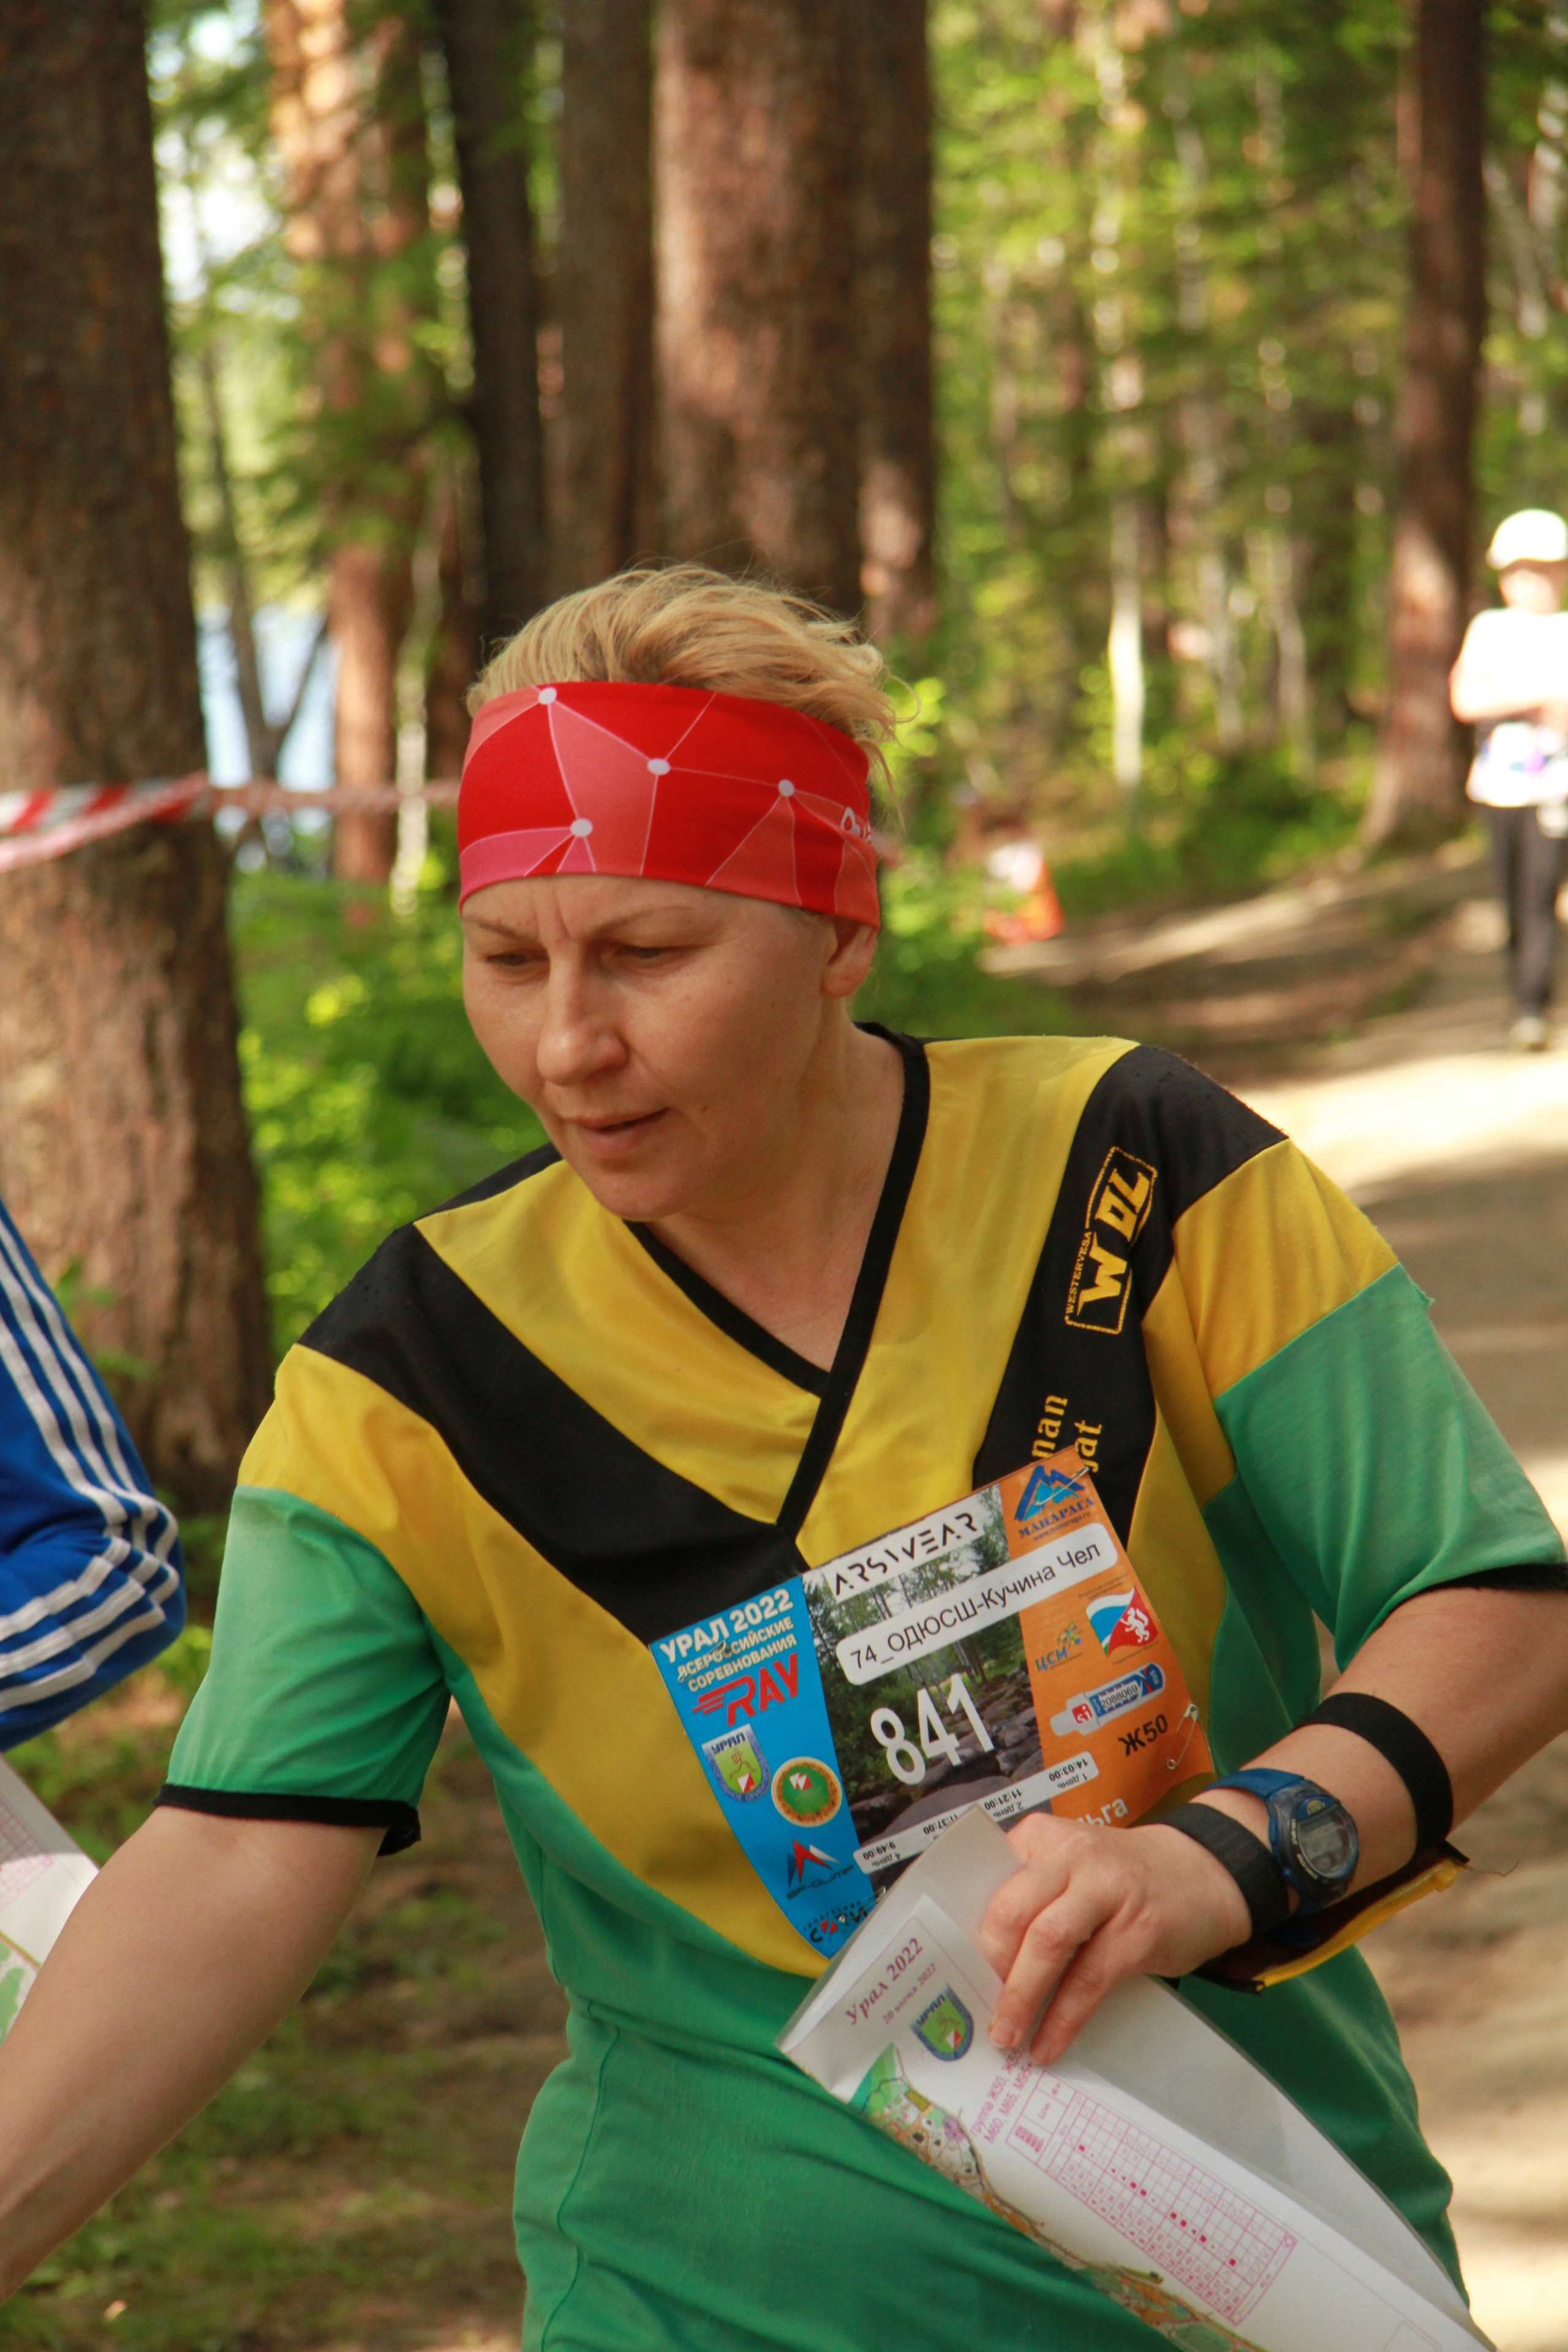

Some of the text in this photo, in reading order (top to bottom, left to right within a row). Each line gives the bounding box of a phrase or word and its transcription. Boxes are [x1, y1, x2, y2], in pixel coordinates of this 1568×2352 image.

[835, 1512, 978, 1596] ARSWEAR
[1057, 1543, 1102, 1569] Чел
[660, 1588, 794, 1664] УРАЛ 2022
[688, 1633, 797, 1692] СОРЕВНОВАНИЯ
[1036, 1646, 1068, 1672] ЦСМ
[692, 1652, 798, 1727] RAY
[1101, 1684, 1139, 1708] 2088069
[870, 1673, 995, 1785] 841
[1117, 1713, 1167, 1757] Ж50
[1049, 1758, 1088, 1782] 14:03:00
[984, 1789, 1022, 1811] 11:21:00
[1077, 1798, 1129, 1826] ьга
[862, 1841, 896, 1860] 9:49:00
[845, 1937, 923, 2026] Урал 2022
